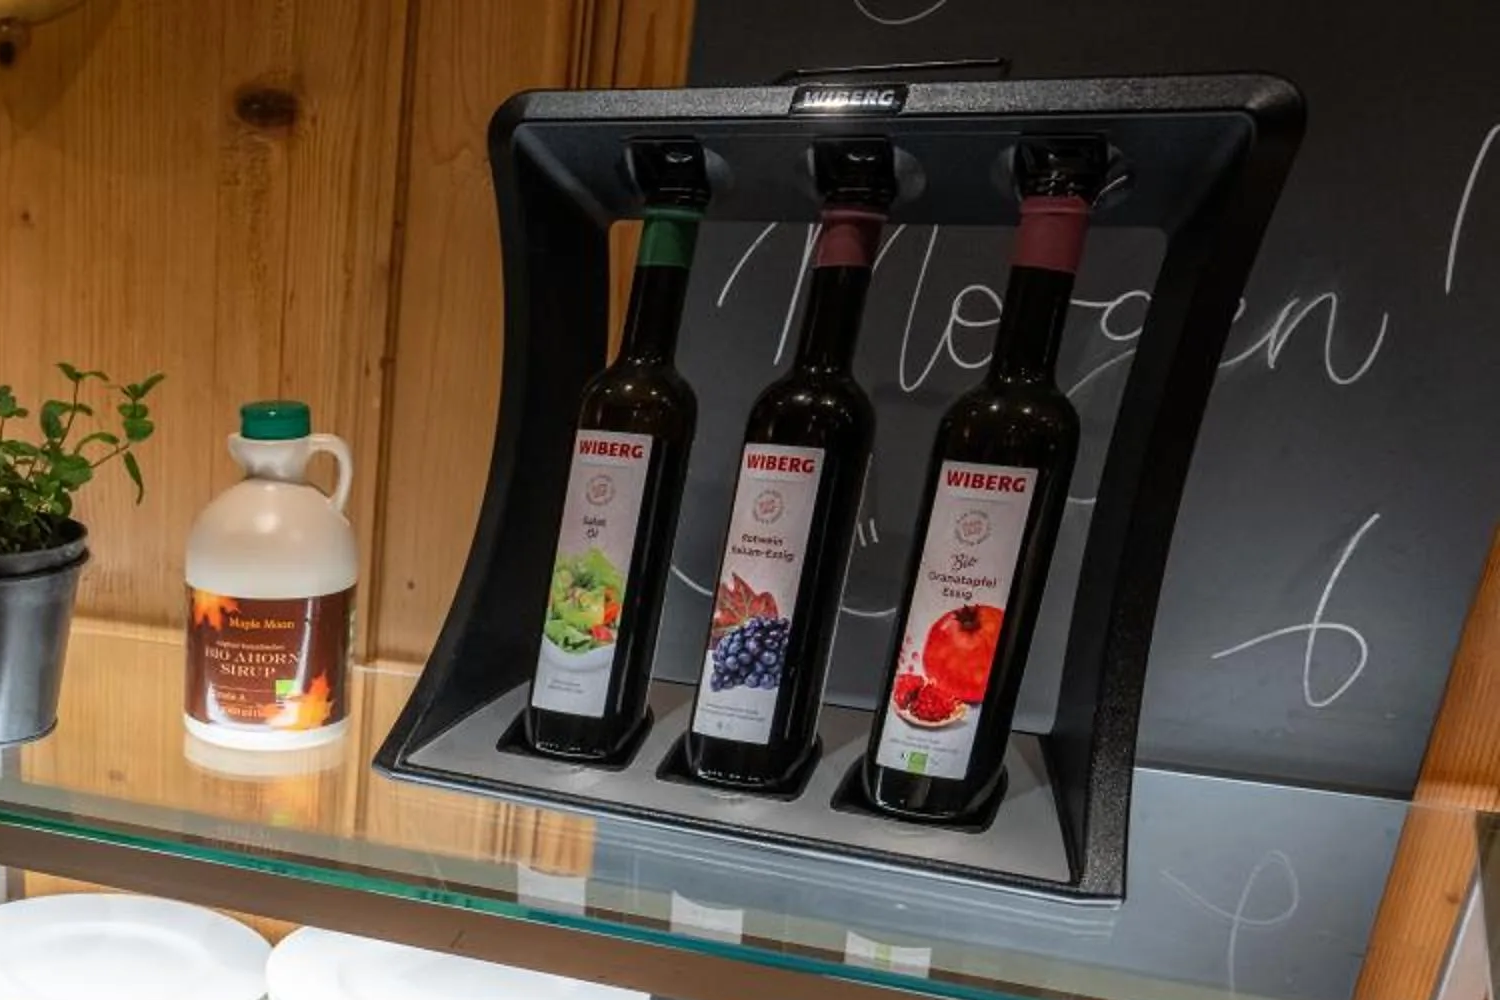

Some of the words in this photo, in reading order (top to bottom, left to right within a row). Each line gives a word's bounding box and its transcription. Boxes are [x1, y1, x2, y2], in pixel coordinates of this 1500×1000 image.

[803, 89, 896, 107] WIBERG
[579, 440, 644, 459] WIBERG
[746, 453, 817, 474] WIBERG
[946, 469, 1027, 493] WIBERG
[927, 571, 998, 589] Granatapfel
[942, 588, 974, 601] Essig
[229, 617, 260, 630] Maple
[205, 646, 232, 661] BIO
[234, 651, 299, 665] AHORN
[220, 664, 276, 678] SIRUP
